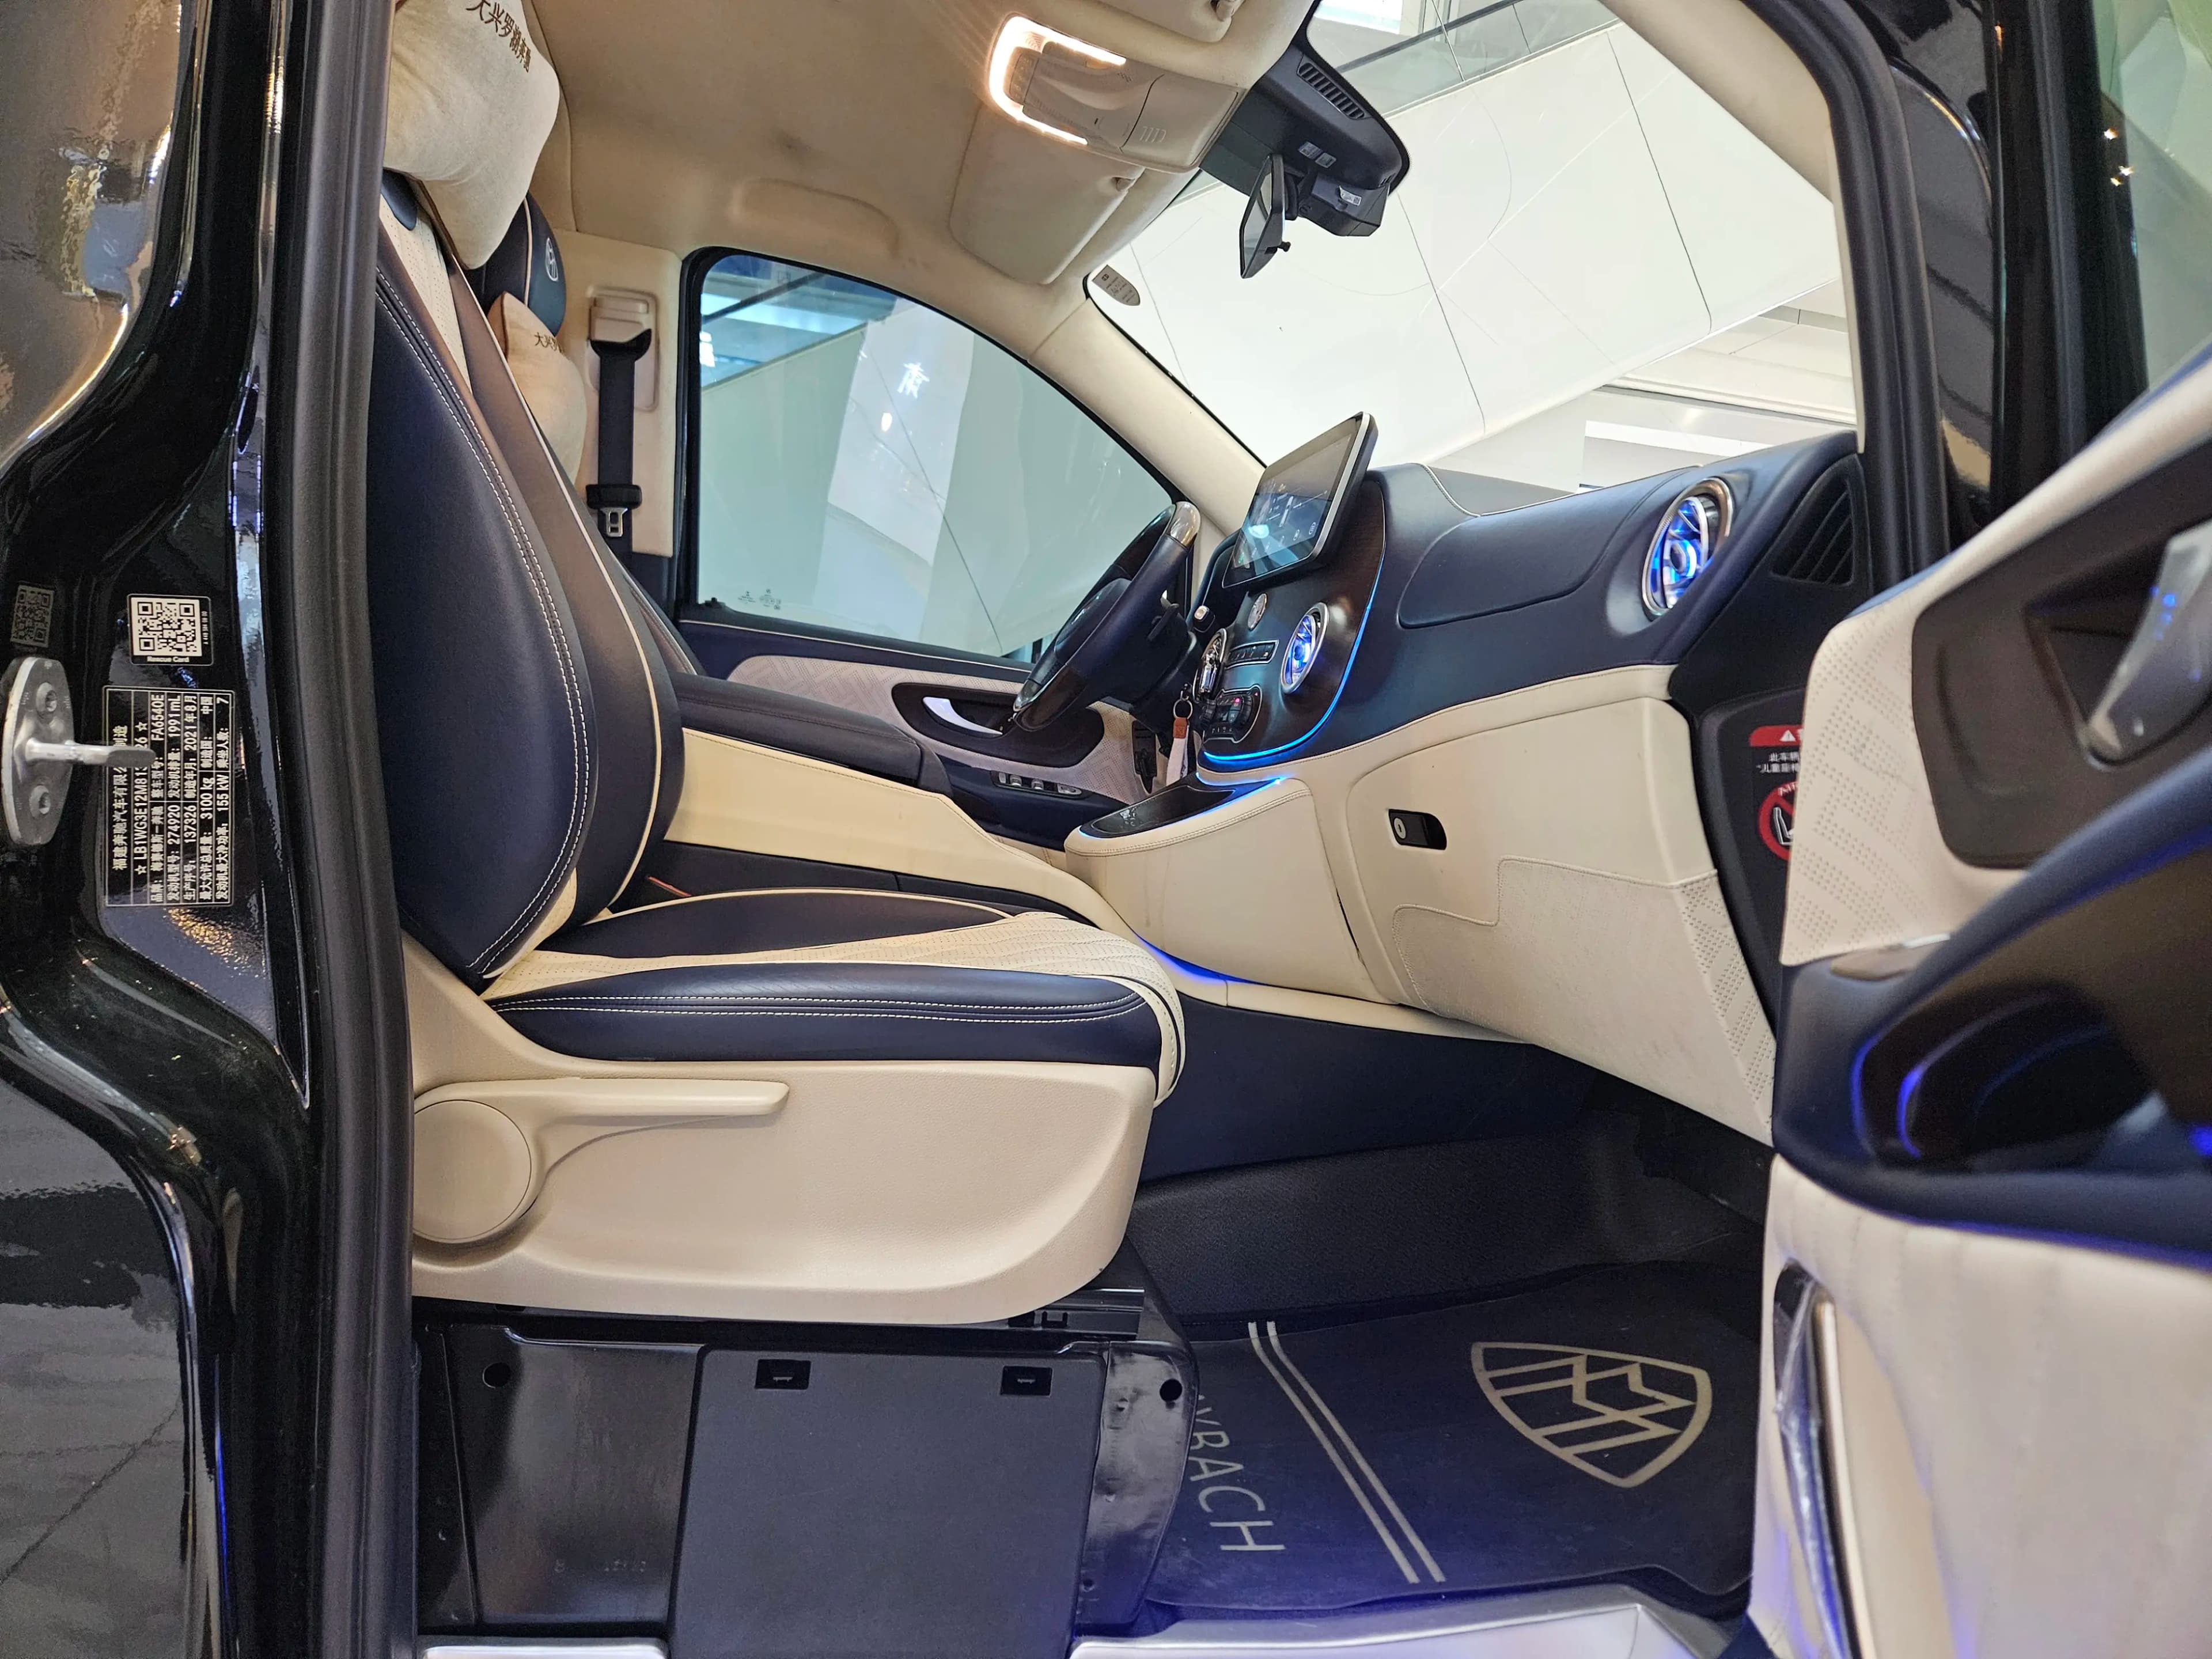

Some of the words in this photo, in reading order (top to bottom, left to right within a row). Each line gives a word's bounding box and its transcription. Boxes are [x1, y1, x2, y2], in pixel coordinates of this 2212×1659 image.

[200, 696, 213, 714] 中国
[151, 694, 164, 741] FA6540E
[200, 777, 215, 790] kg
[216, 774, 229, 790] kW
[200, 793, 213, 820] 3100
[216, 793, 229, 811] 155
[167, 805, 180, 845] 274920
[183, 805, 196, 843] 137326
